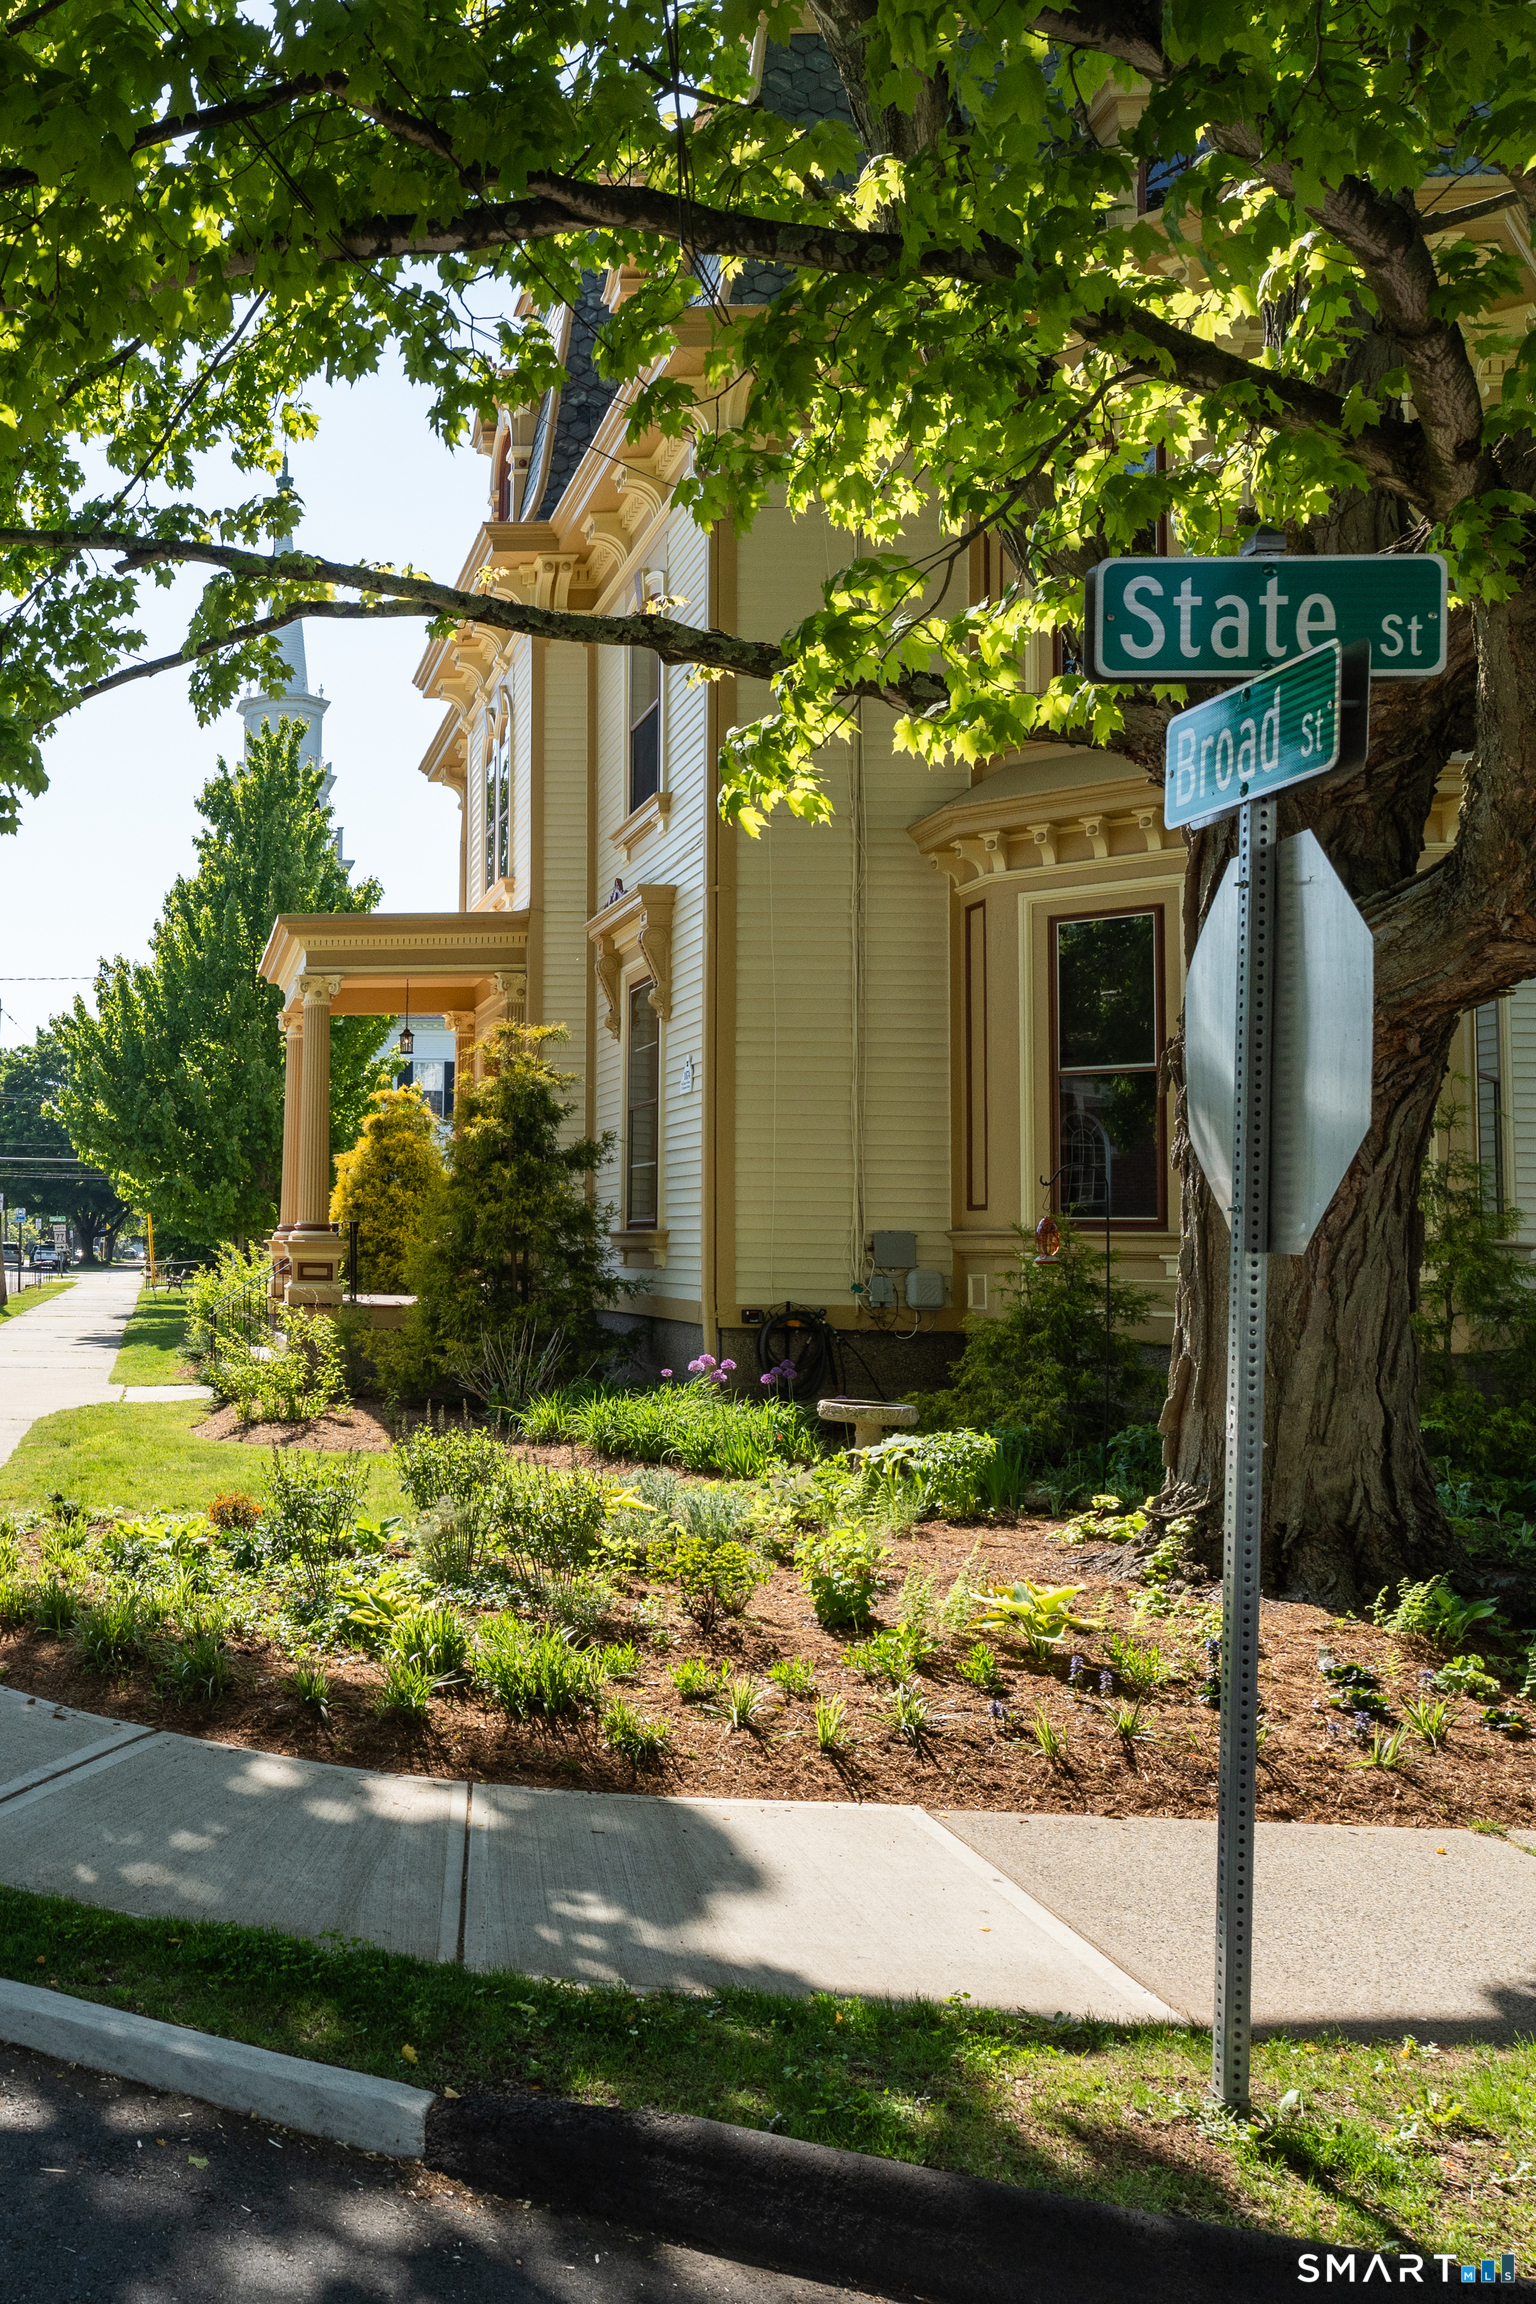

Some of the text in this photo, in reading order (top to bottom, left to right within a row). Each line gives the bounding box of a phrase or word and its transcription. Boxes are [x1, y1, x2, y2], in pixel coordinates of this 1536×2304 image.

[1120, 575, 1423, 659] State St
[1176, 686, 1323, 808] Broad St
